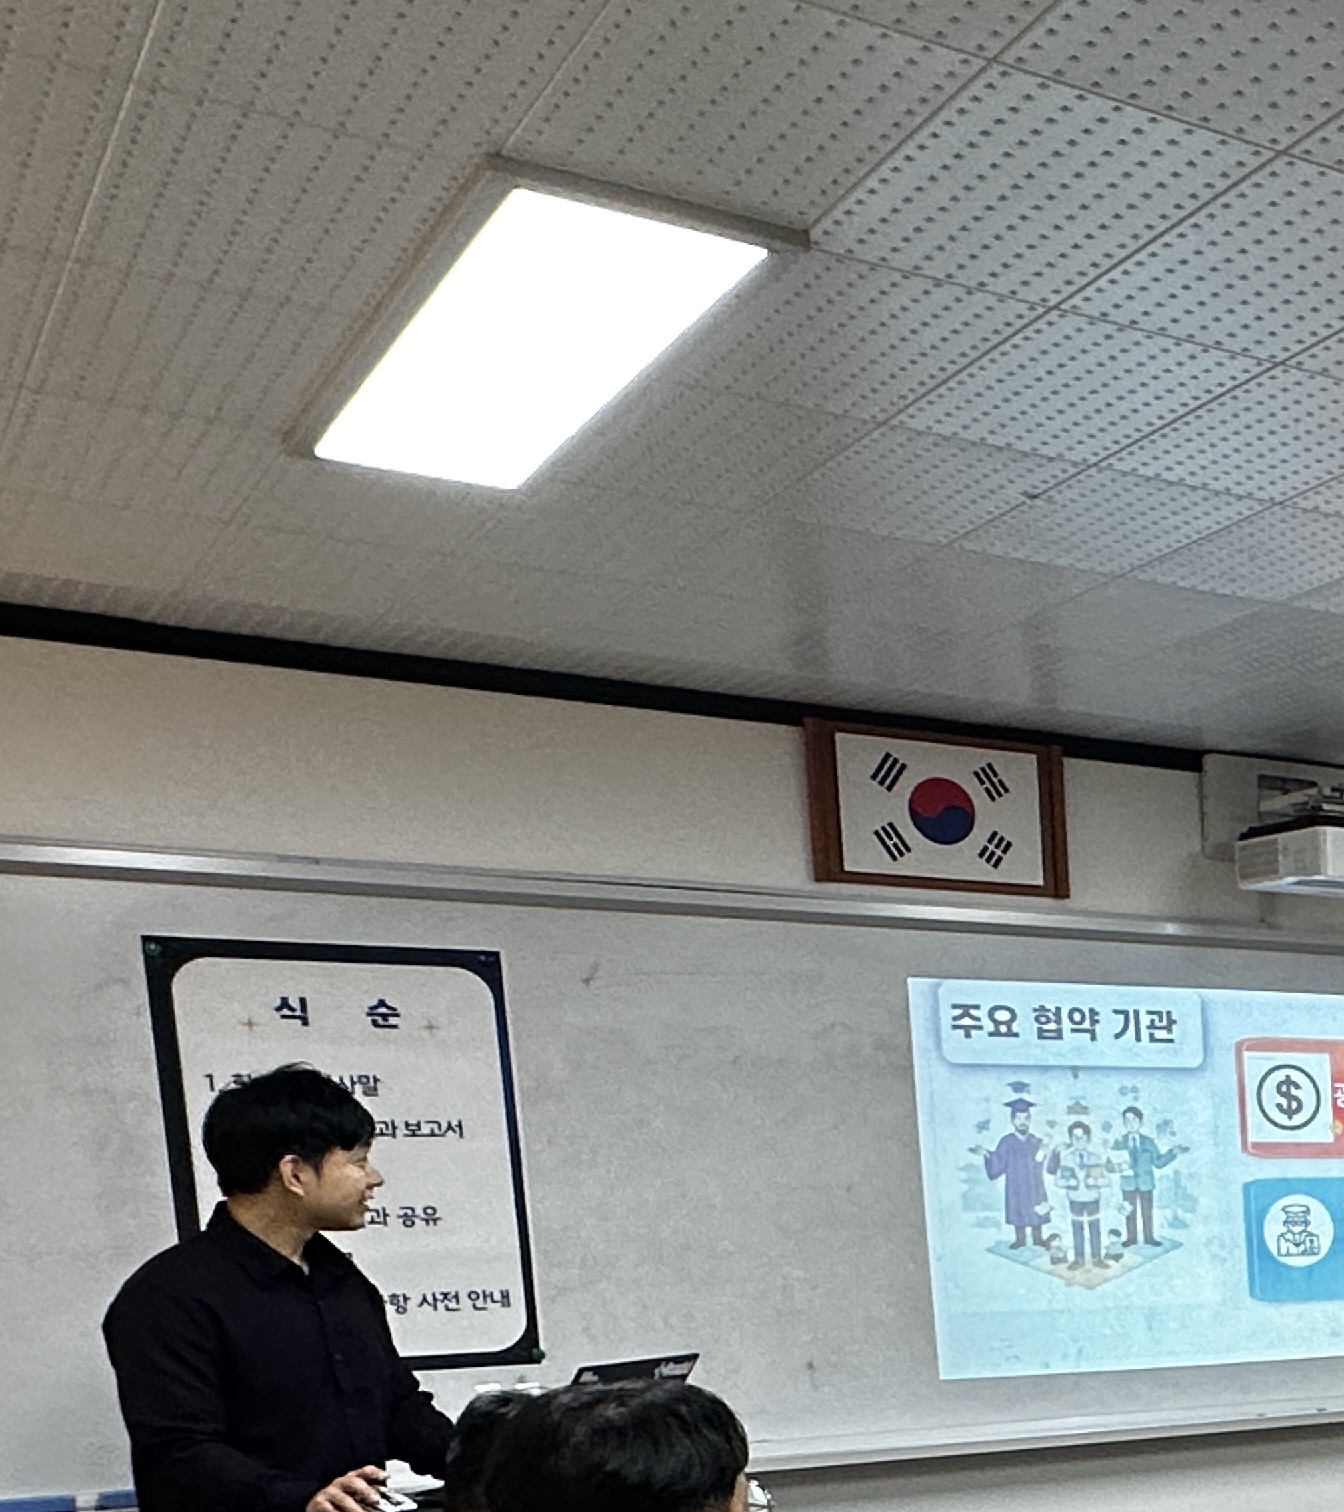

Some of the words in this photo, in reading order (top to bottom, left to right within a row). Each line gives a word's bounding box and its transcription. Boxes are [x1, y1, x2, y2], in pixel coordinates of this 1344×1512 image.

[274, 996, 310, 1027] 식
[366, 998, 400, 1029] 순
[950, 1003, 1020, 1039] 주요
[1032, 1004, 1100, 1042] 협약
[1112, 1008, 1178, 1044] 기관
[326, 1073, 381, 1097] 사말
[374, 1118, 398, 1139] 과
[403, 1118, 465, 1140] 보고서
[365, 1206, 390, 1227] 과
[396, 1205, 442, 1228] 공유
[384, 1292, 412, 1315] 항
[417, 1291, 462, 1312] 사전
[466, 1288, 511, 1310] 안내
